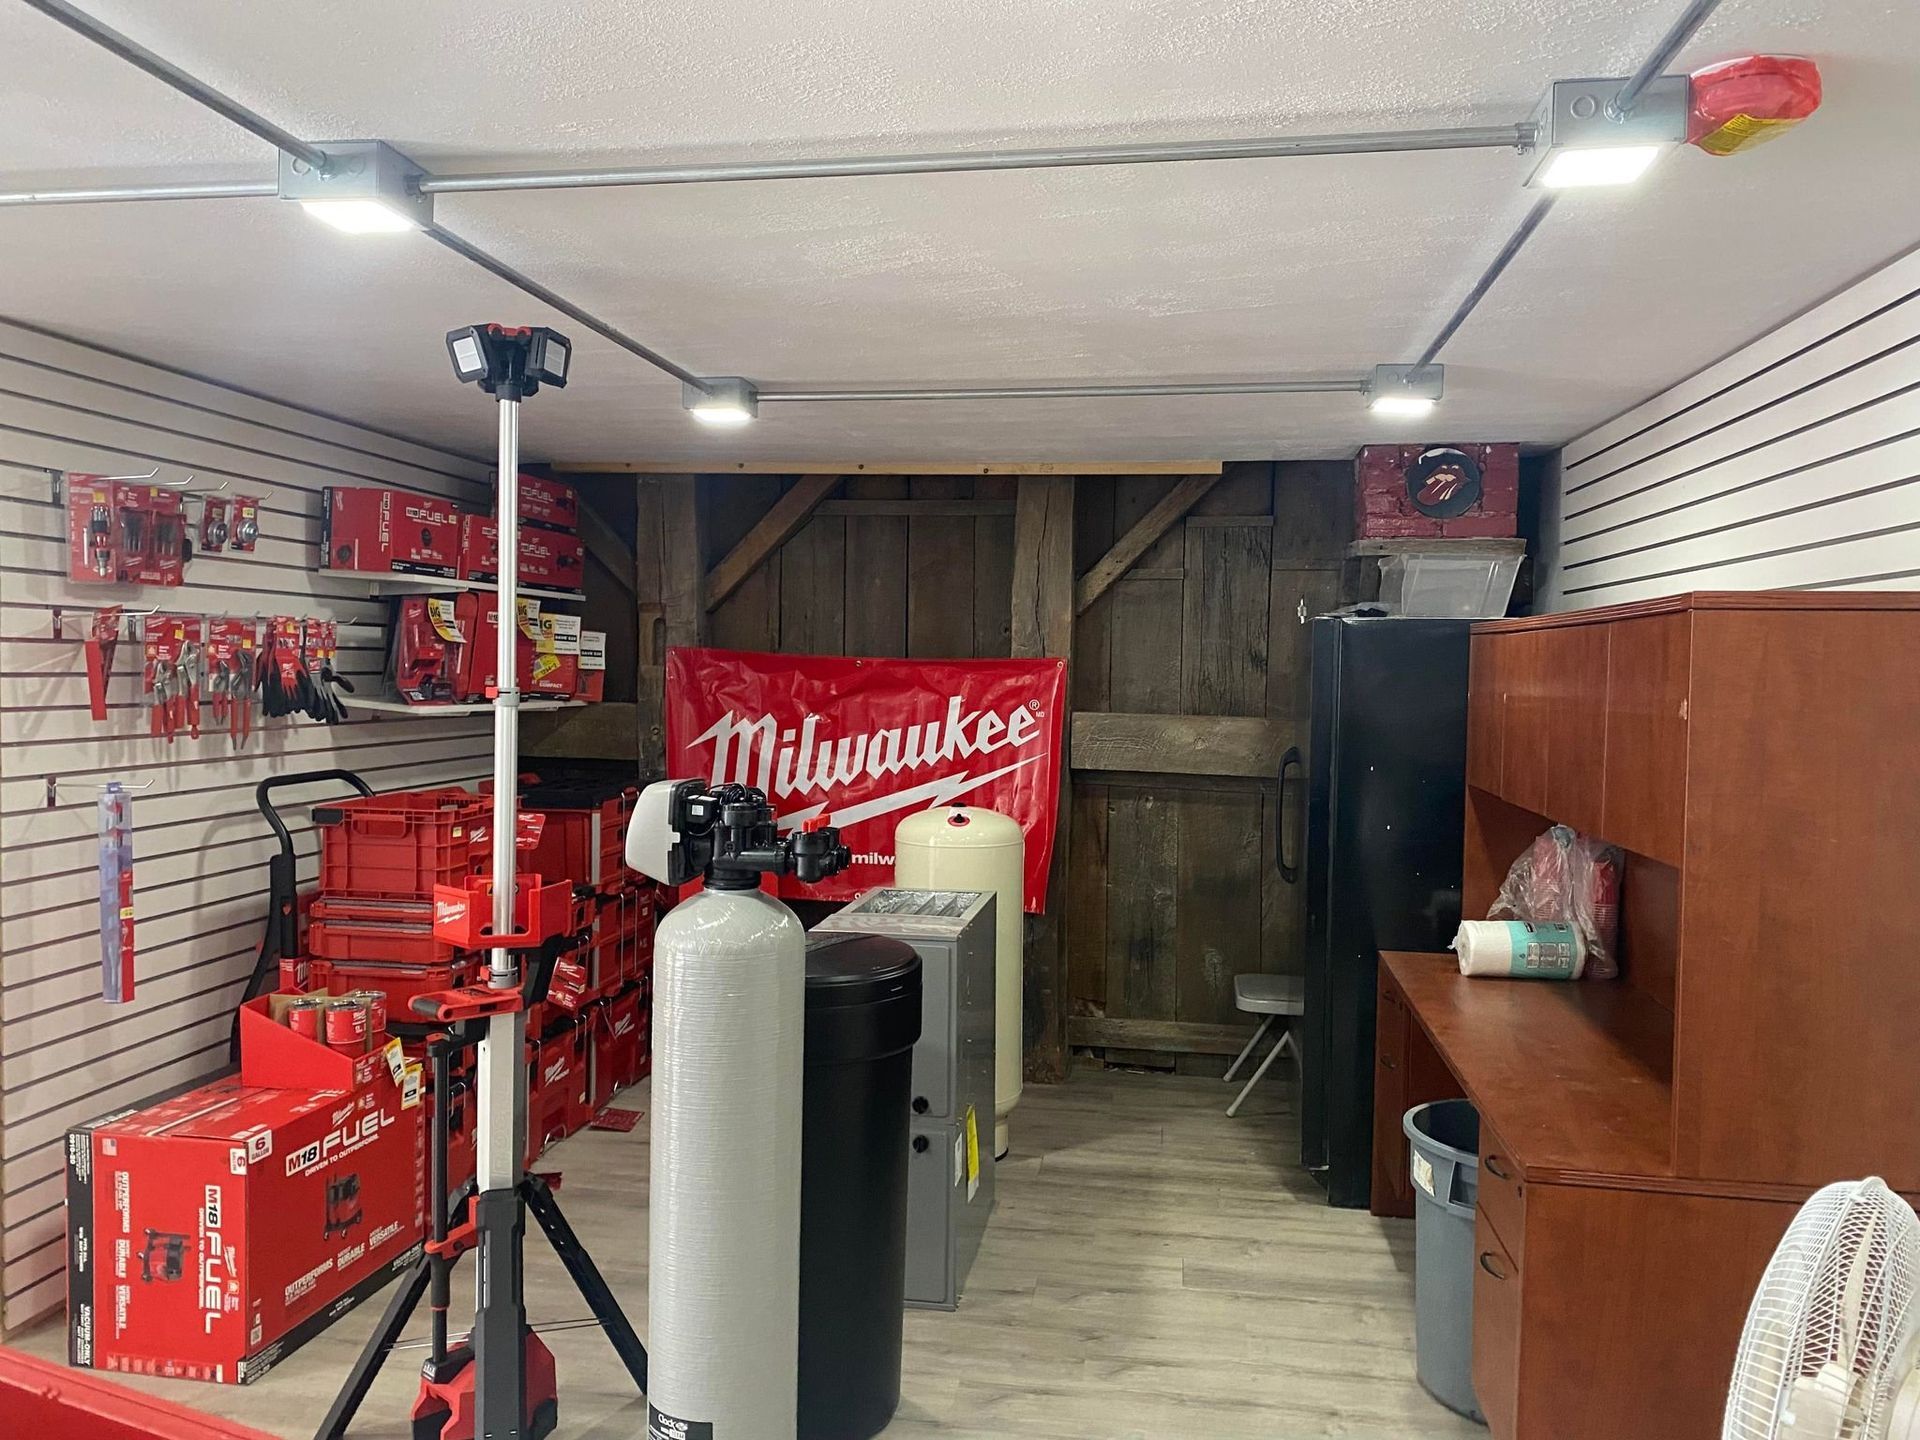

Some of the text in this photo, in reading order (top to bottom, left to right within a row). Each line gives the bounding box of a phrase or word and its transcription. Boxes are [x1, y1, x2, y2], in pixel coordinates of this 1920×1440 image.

[382, 511, 390, 553] FUEL
[420, 509, 447, 524] FUEL
[685, 696, 1040, 799] Milwaukee
[255, 1136, 266, 1151] 6
[287, 1108, 395, 1174] M18 FUEL
[305, 1159, 329, 1177] DRIVEN
[329, 1154, 338, 1163] TO
[122, 1172, 130, 1234] OUTPERFORMS
[198, 1239, 205, 1251] TO
[369, 1221, 398, 1246] VERSATILE
[118, 1239, 126, 1278] DURABLE
[205, 1187, 222, 1334] M18 FUEL
[338, 1242, 365, 1268] DURABLE
[118, 1284, 126, 1328] VERSATILE
